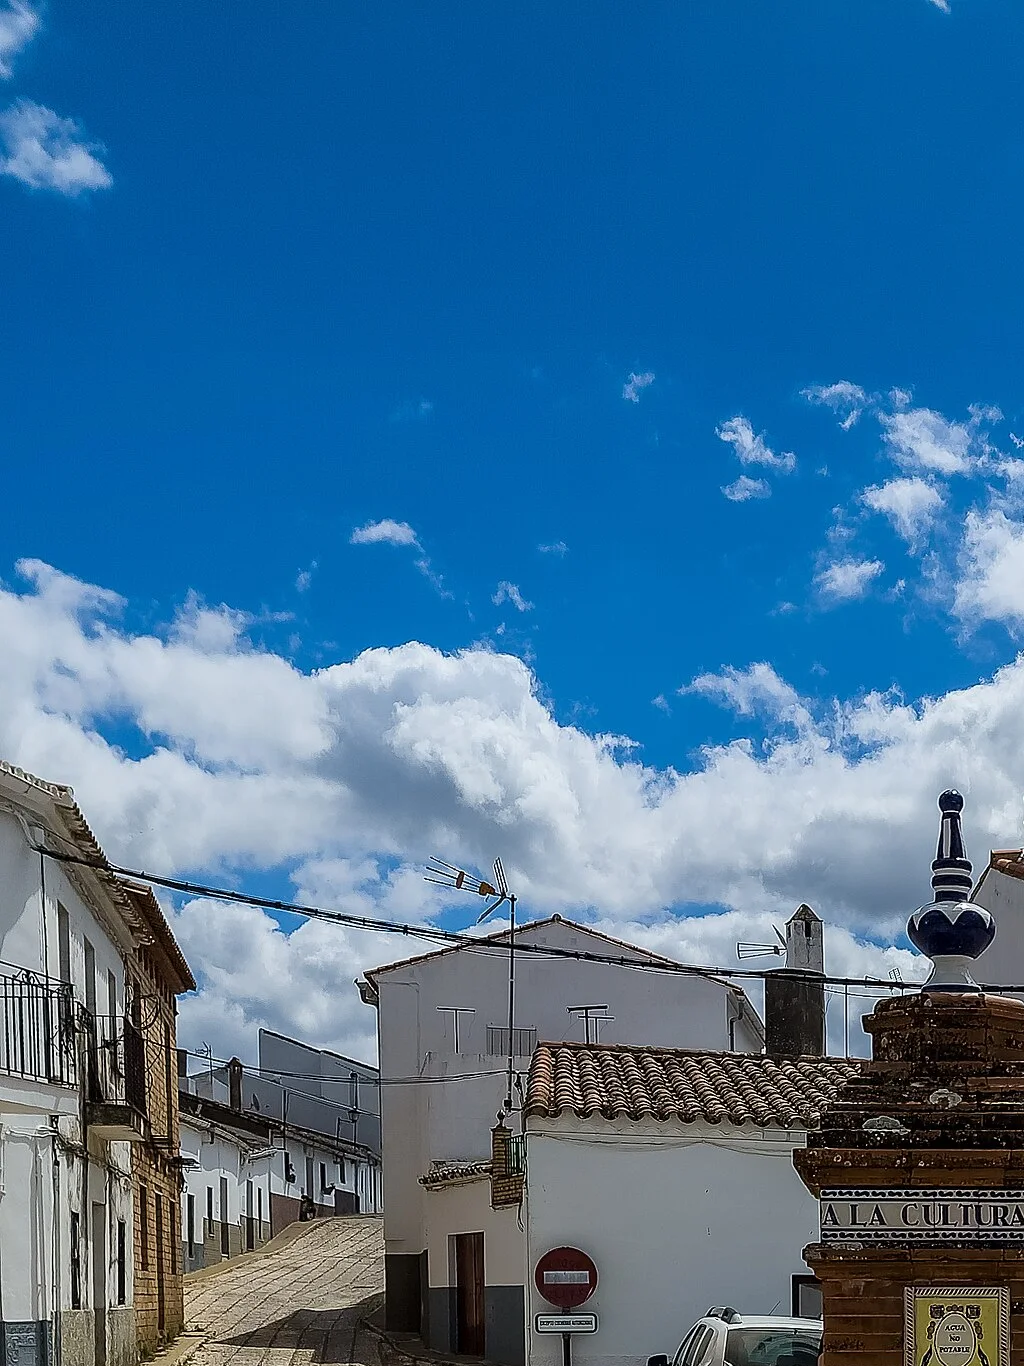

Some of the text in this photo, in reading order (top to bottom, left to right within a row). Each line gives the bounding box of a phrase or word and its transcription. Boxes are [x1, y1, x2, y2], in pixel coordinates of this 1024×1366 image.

[822, 1204, 839, 1226] A
[850, 1204, 887, 1226] LA
[939, 1346, 970, 1354] POTABLE
